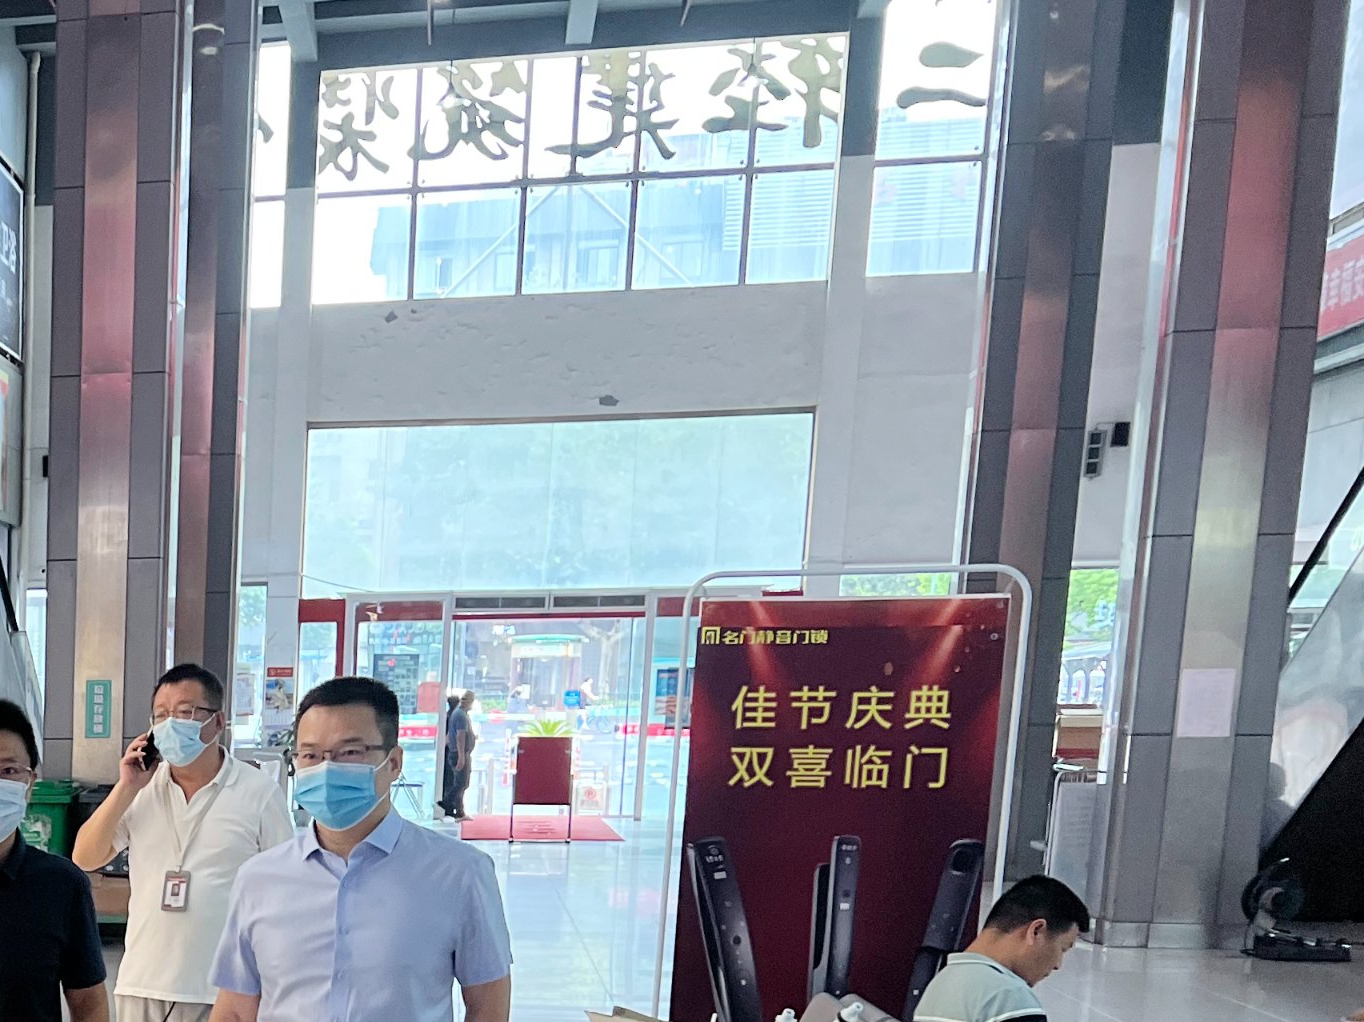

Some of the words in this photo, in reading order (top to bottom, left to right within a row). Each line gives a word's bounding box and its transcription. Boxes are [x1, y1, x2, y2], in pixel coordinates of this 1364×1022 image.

[721, 629, 829, 645] 名门静音门锁
[730, 685, 952, 730] 佳节庆典
[727, 744, 949, 789] 双喜临门
